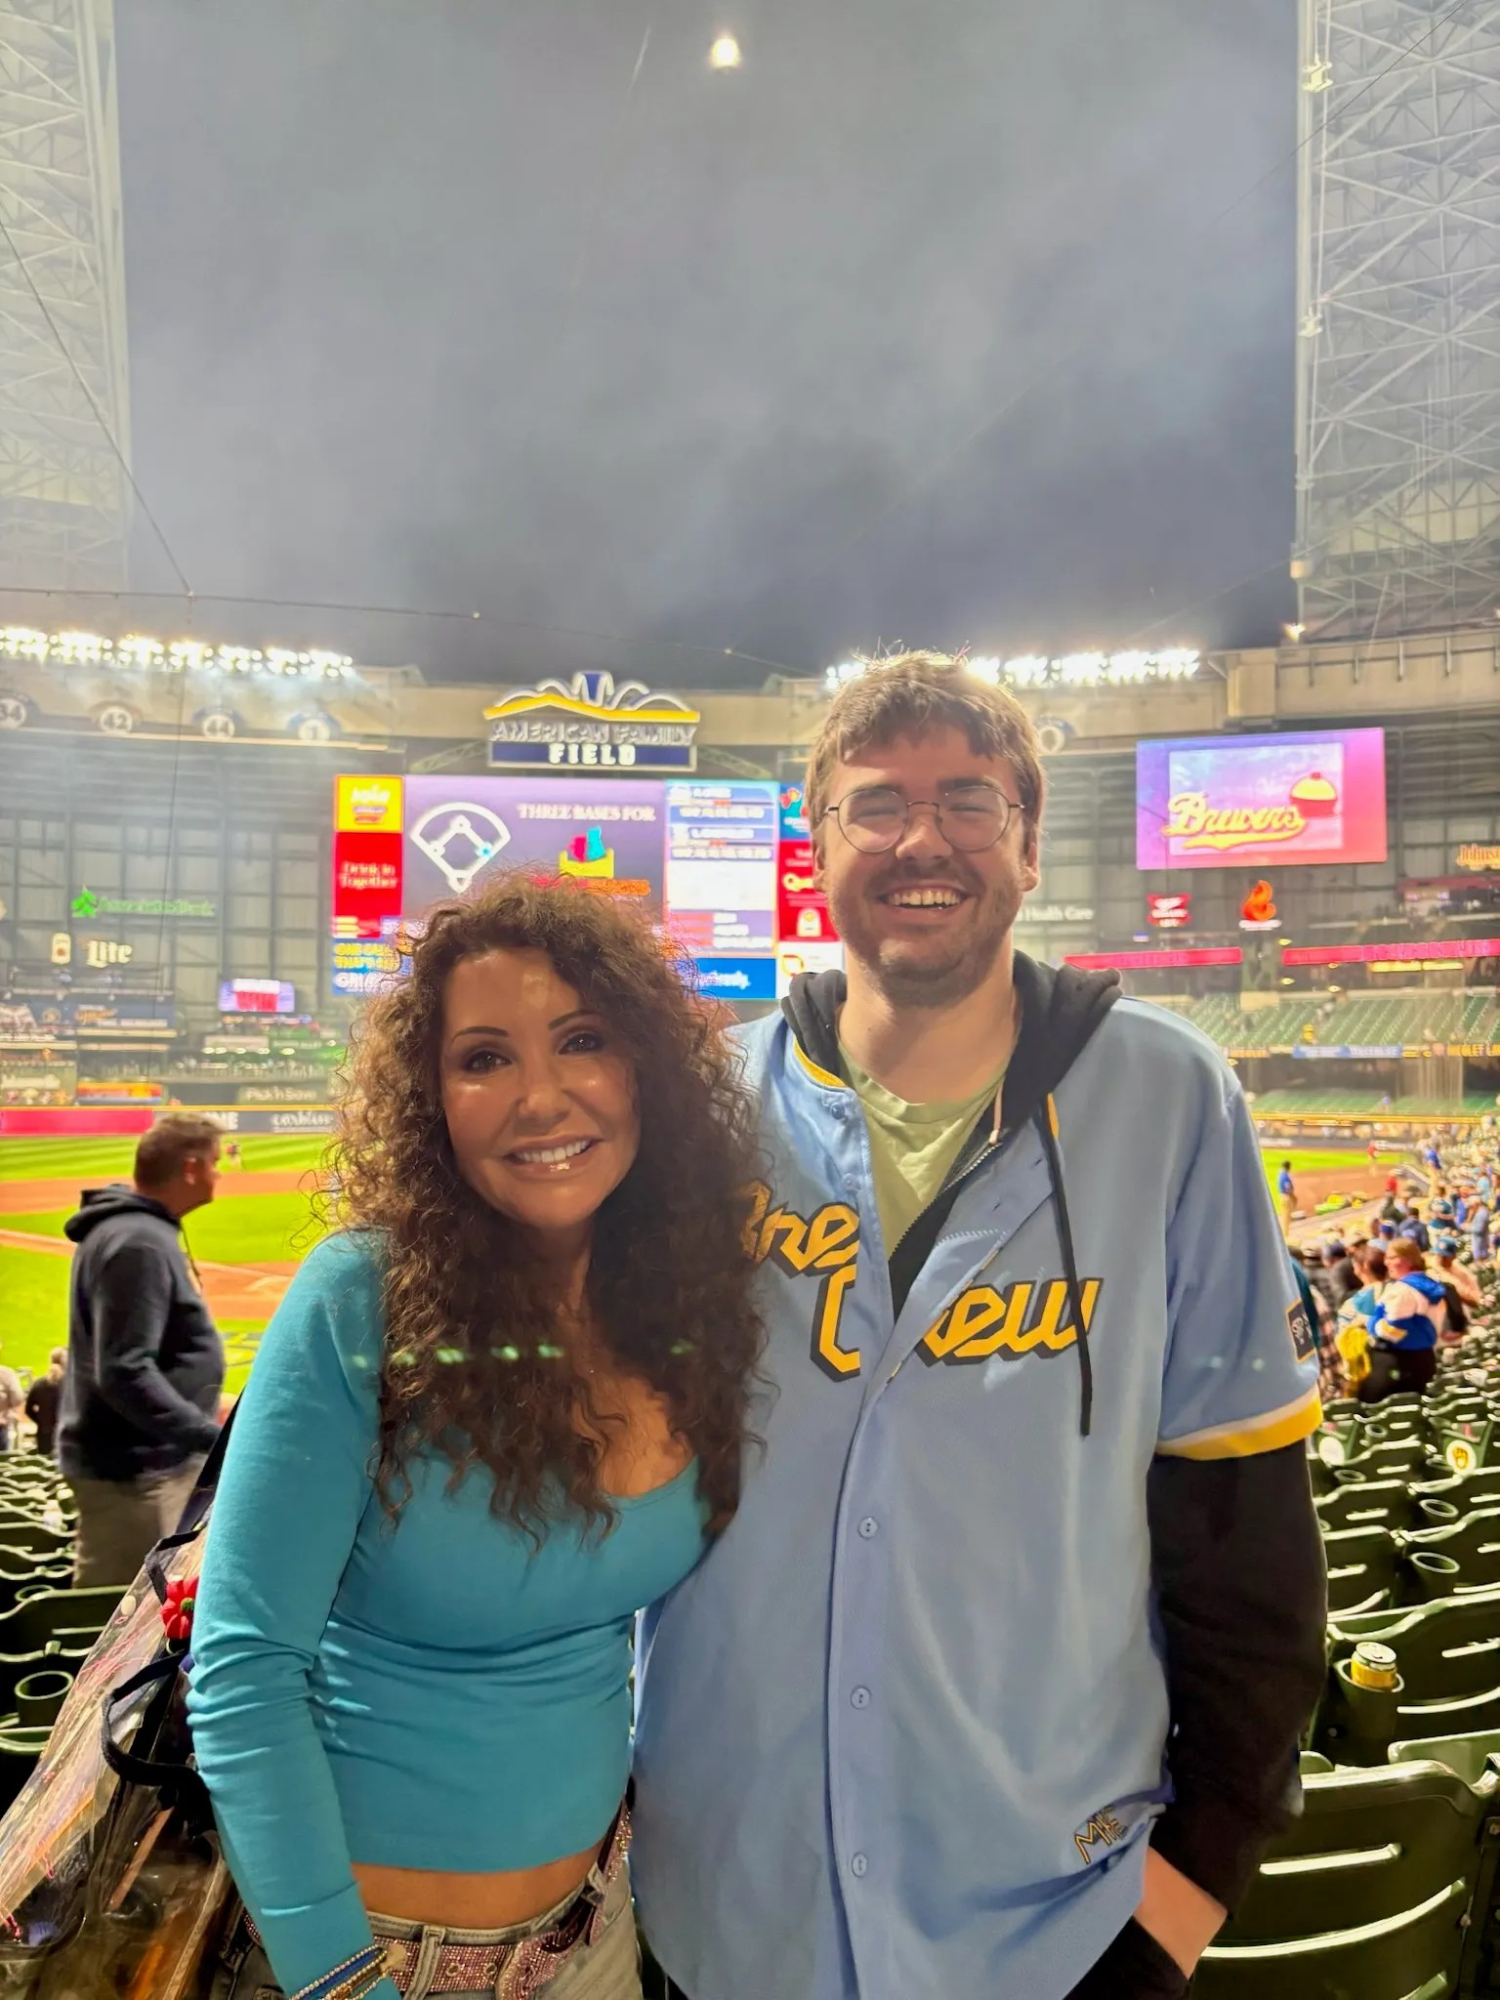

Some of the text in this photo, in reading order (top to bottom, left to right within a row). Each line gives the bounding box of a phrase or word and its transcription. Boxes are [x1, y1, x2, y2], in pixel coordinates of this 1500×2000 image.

[103, 713, 127, 730] 42
[491, 722, 697, 746] AMERICAN FAMILY
[549, 742, 636, 766] FIELD
[517, 804, 571, 819] THREE
[622, 806, 656, 821] FOR
[1161, 791, 1308, 837] Brewers
[86, 940, 132, 968] Lite
